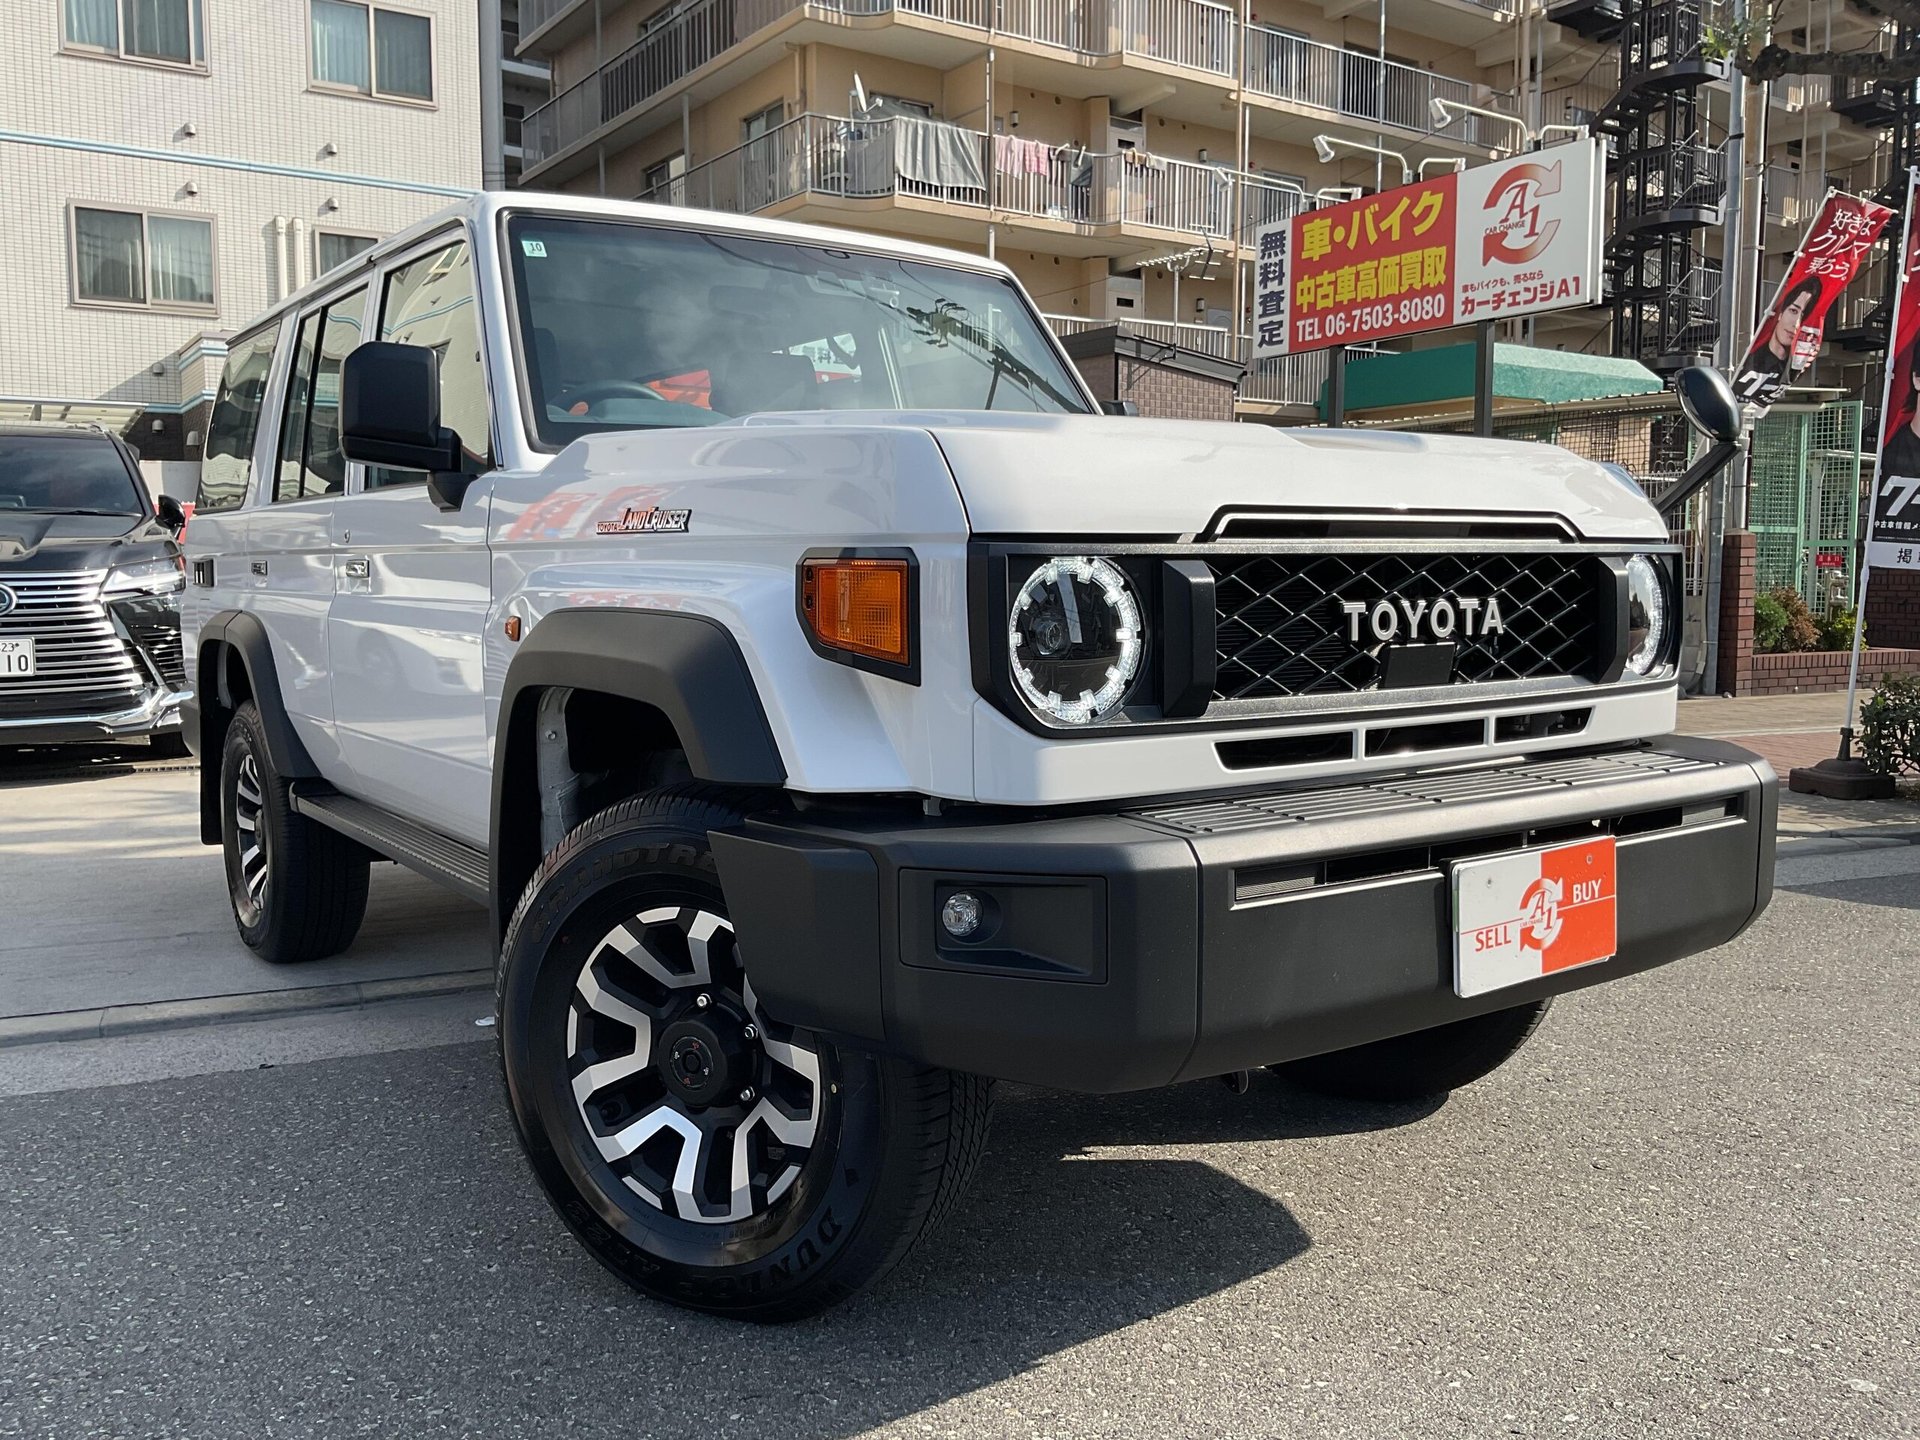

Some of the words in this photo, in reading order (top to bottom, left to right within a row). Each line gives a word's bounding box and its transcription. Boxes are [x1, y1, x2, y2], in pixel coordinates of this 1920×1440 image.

[1499, 219, 1526, 233] CHANGE
[1830, 208, 1877, 236] 好きな
[1808, 228, 1871, 260] クルマ
[1258, 229, 1287, 348] 無料査定
[1296, 245, 1448, 313] 中古車高価買取
[1296, 318, 1322, 343] TEL
[1324, 293, 1446, 338] 06-7503-8080
[1342, 597, 1504, 642] TOYOTA
[1573, 878, 1602, 904] BUY
[1475, 925, 1512, 952] SELL
